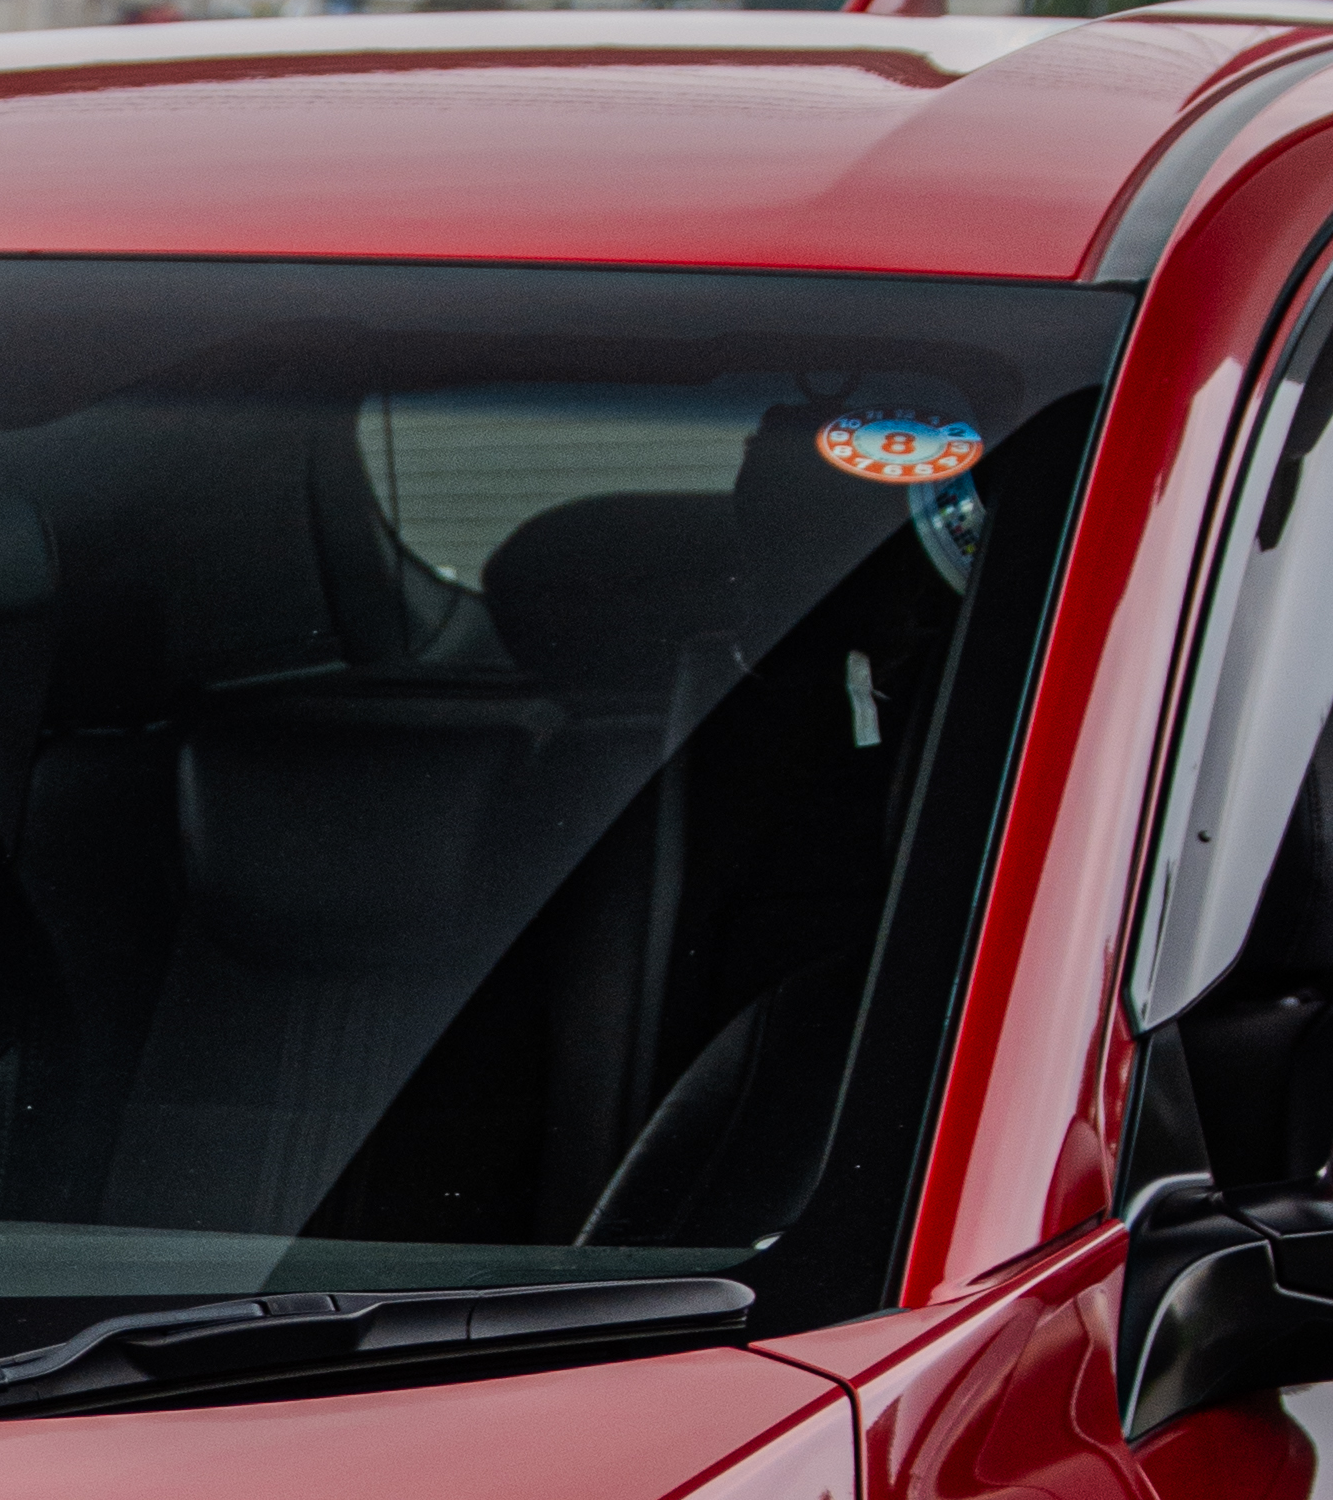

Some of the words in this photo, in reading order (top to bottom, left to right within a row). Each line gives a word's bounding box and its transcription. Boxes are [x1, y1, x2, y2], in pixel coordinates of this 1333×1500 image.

[829, 430, 850, 442] 9
[947, 426, 966, 437] 2
[881, 431, 916, 455] 8
[833, 445, 853, 457] 8
[854, 457, 874, 470] 7
[938, 455, 959, 467] 4
[883, 464, 903, 476] 6
[914, 464, 933, 476] 5
